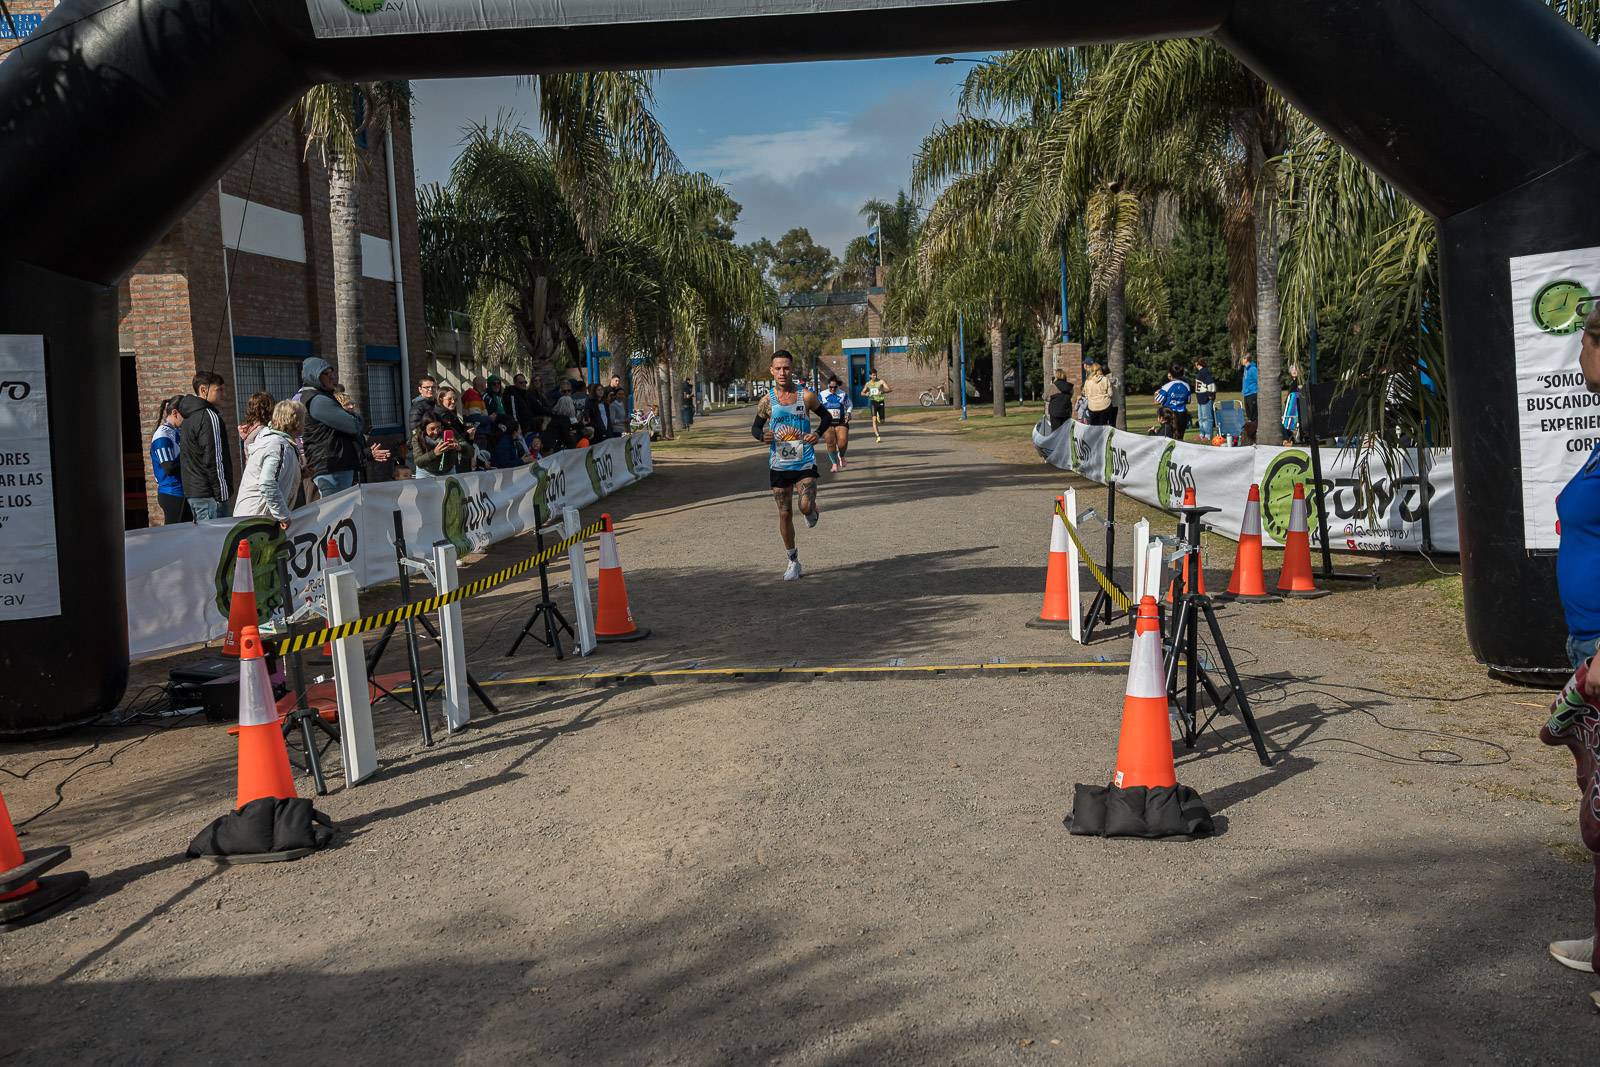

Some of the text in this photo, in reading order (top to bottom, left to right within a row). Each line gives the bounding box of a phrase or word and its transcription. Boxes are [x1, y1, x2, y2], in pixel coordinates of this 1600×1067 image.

[373, 2, 404, 12] RAV
[1537, 373, 1587, 388] “SOMO
[1527, 394, 1600, 411] BUSCANDO
[782, 447, 797, 457] 64
[19, 472, 44, 486] LAS
[8, 494, 32, 508] LOS
